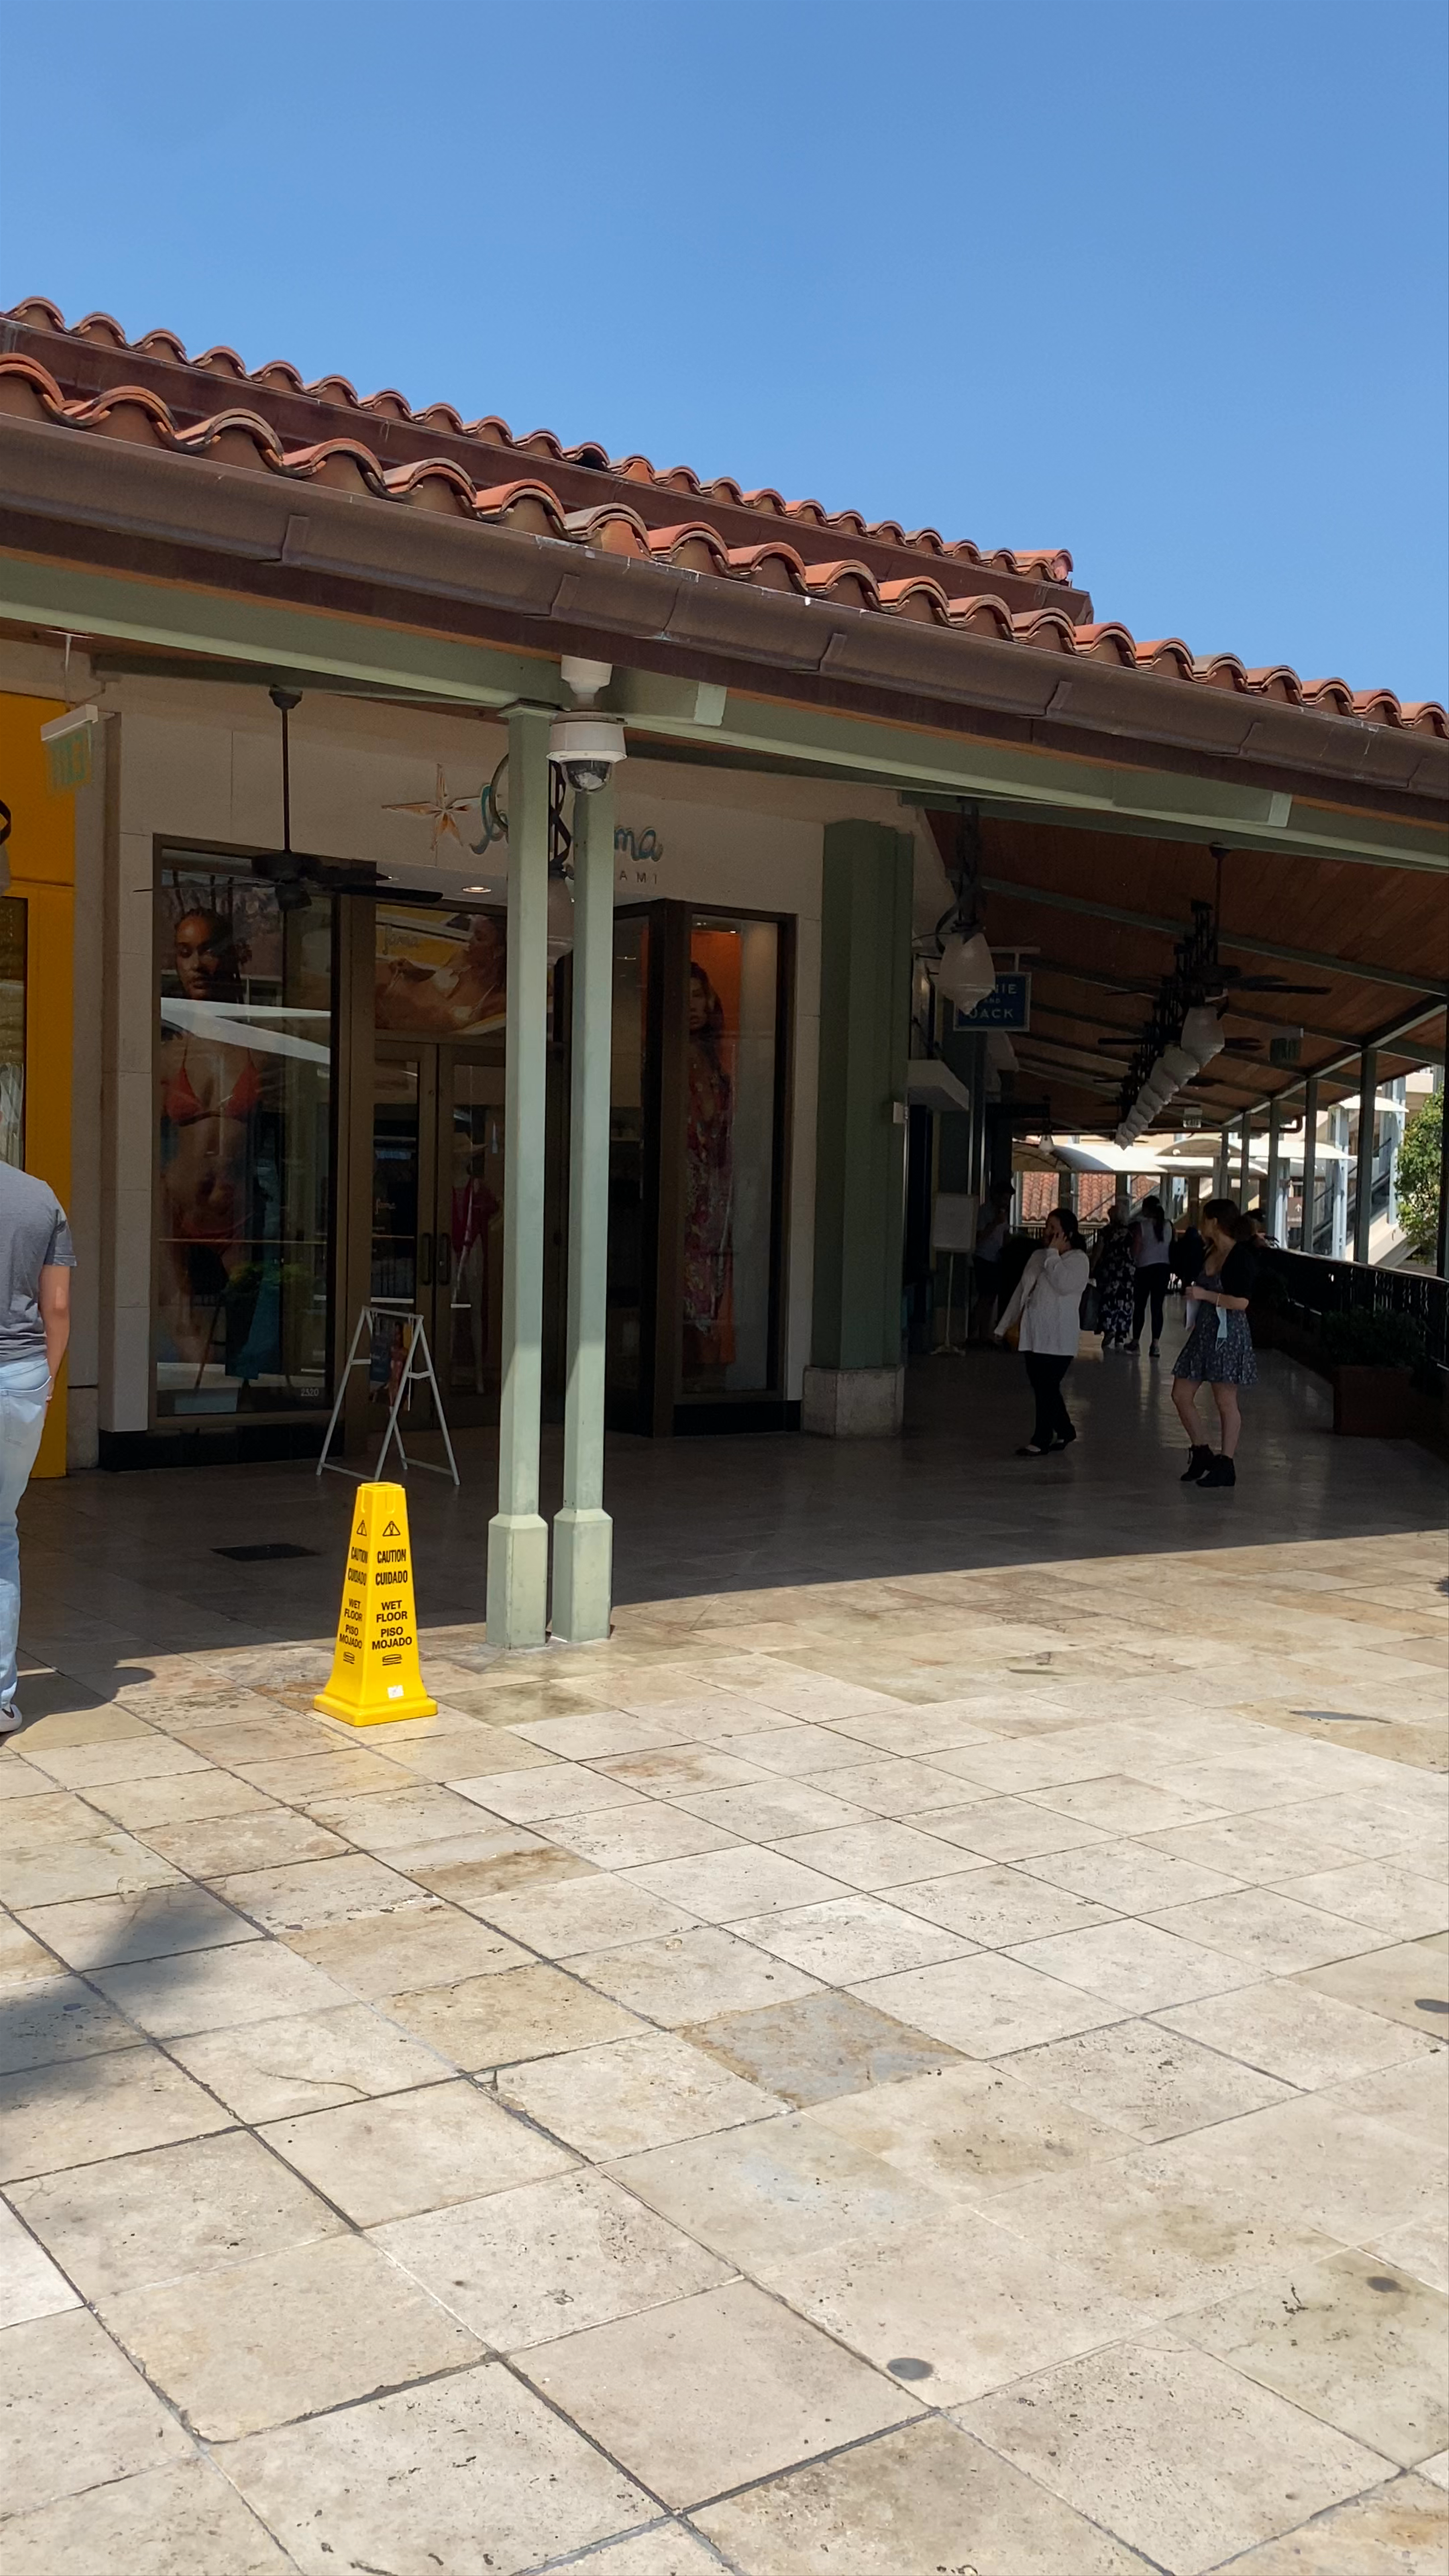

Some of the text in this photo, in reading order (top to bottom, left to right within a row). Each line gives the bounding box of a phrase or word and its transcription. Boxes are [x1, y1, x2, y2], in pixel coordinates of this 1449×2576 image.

[615, 826, 663, 862] ma
[620, 870, 657, 884] AMI
[969, 1008, 1014, 1019] JACK
[351, 1546, 368, 1563] CAUTION
[377, 1549, 406, 1563] CAUTION
[375, 1570, 408, 1586] CUIDADO
[349, 1598, 361, 1609] WET
[381, 1600, 402, 1610] WET
[345, 1608, 362, 1621] FLOOR
[376, 1611, 408, 1622] FLOOR
[345, 1624, 358, 1636] PISO
[381, 1627, 403, 1637] PISO
[339, 1633, 362, 1649] MOJADO
[372, 1637, 412, 1650] MOJADO
